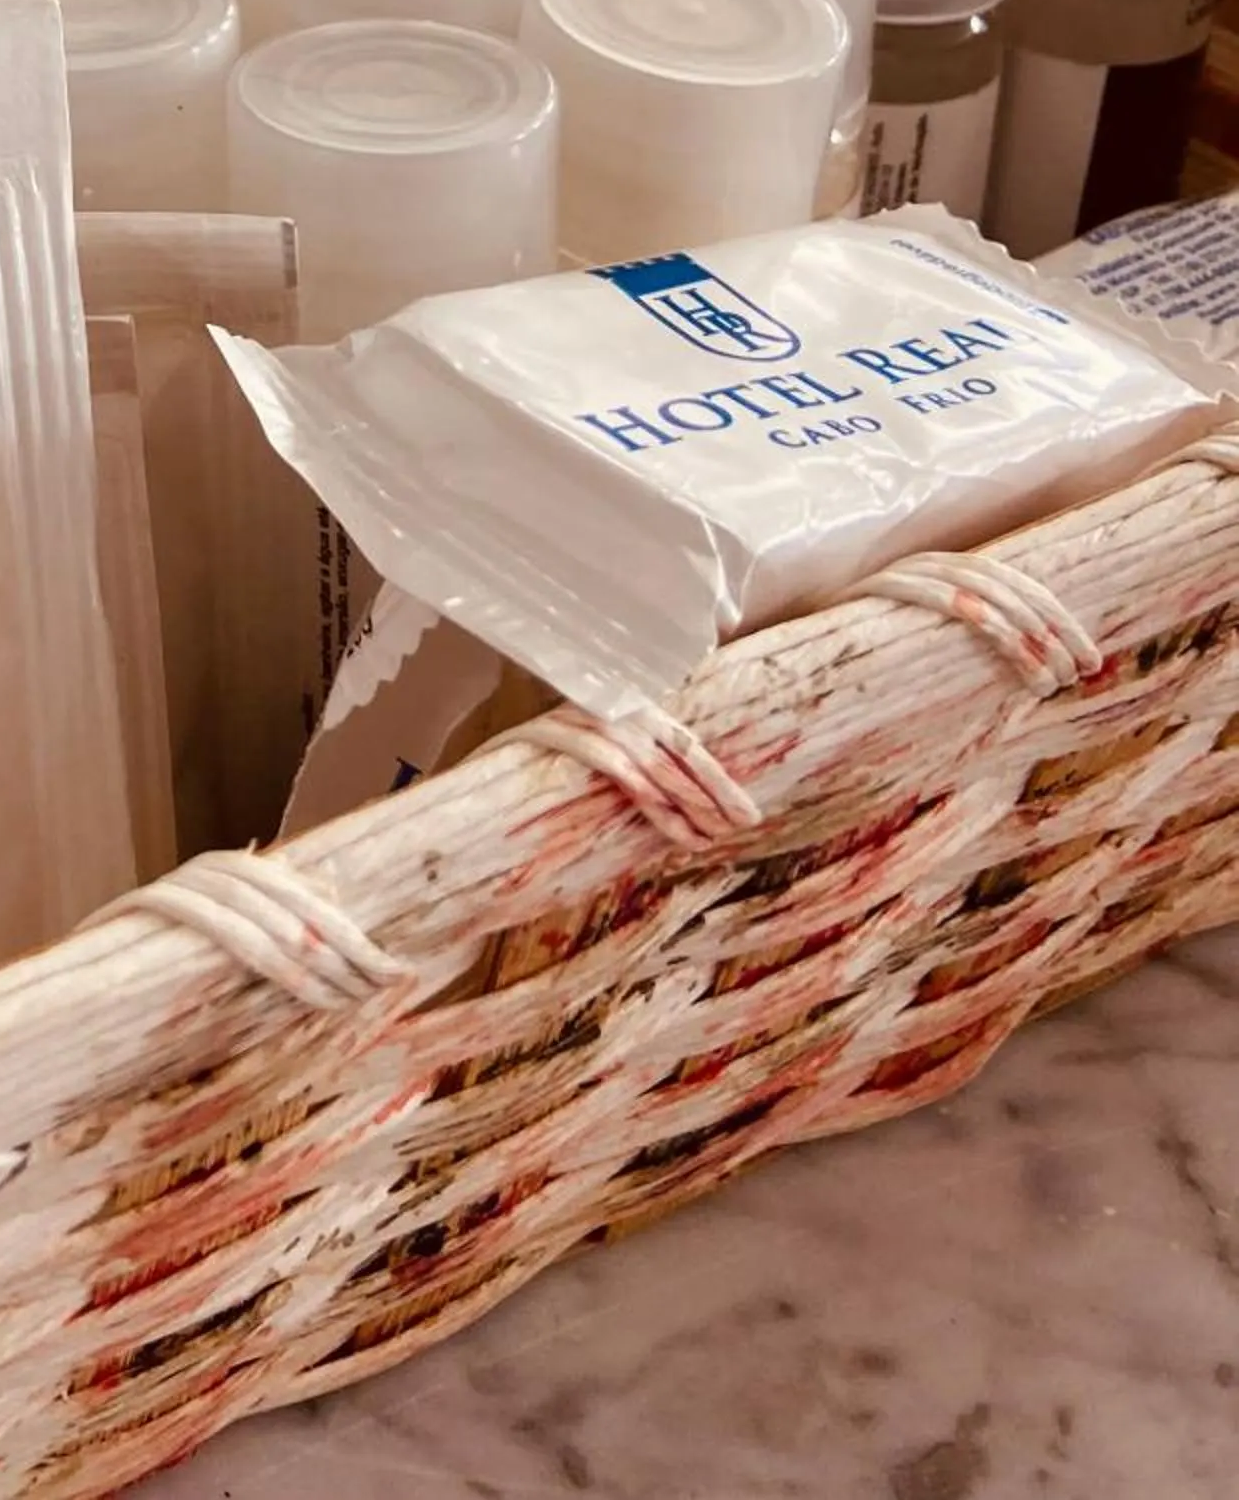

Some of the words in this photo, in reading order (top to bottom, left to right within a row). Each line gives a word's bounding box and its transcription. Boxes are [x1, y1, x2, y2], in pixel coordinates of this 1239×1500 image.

[574, 371, 863, 452] HOTEL
[768, 414, 882, 449] CABO
[895, 377, 997, 414] FRIO
